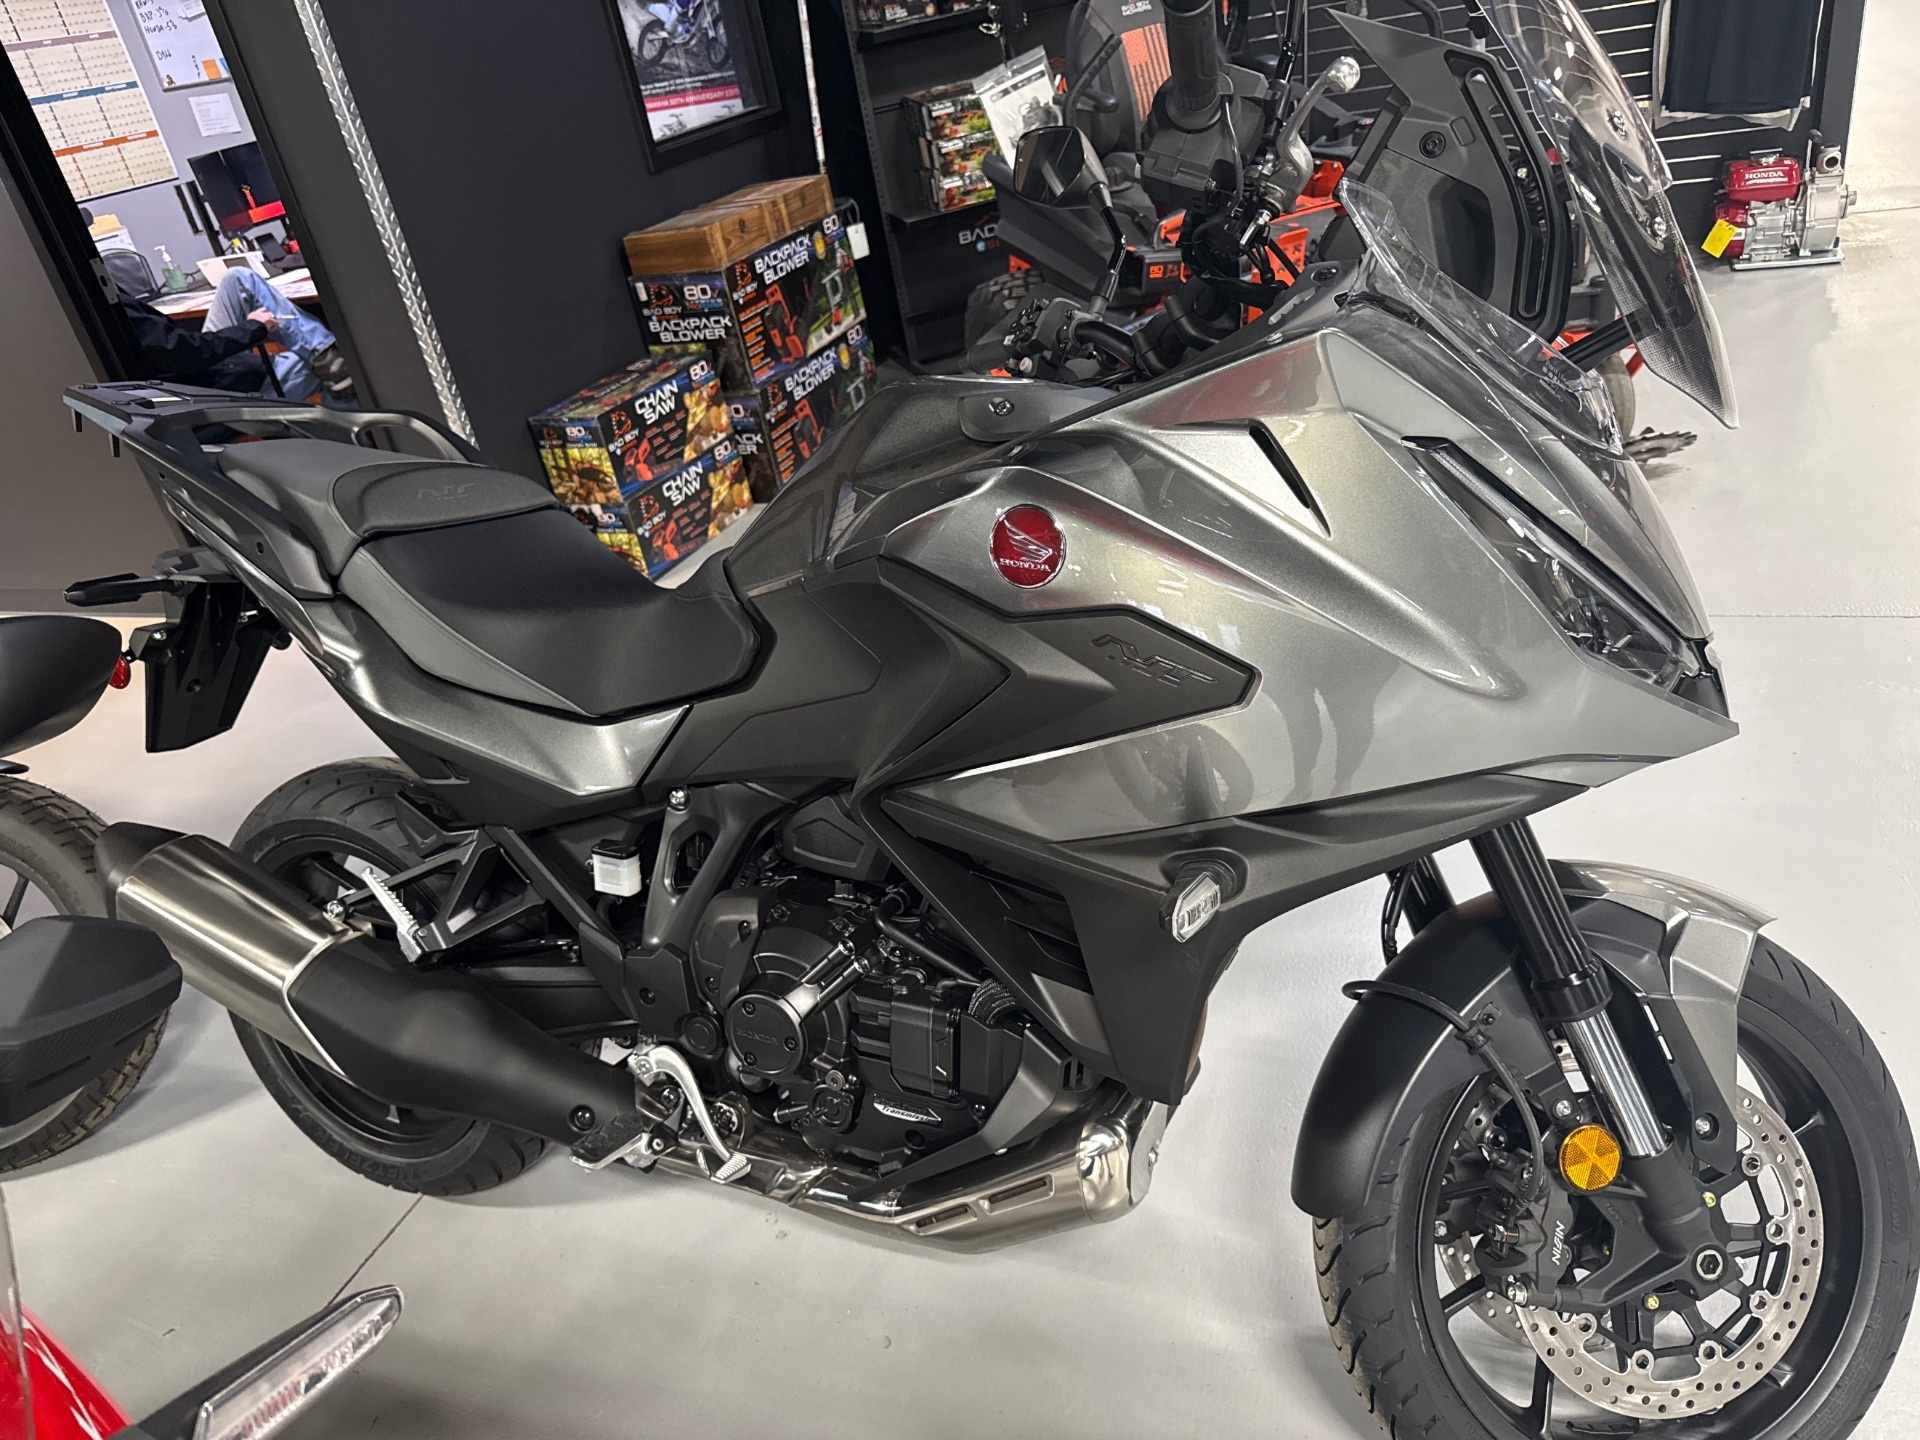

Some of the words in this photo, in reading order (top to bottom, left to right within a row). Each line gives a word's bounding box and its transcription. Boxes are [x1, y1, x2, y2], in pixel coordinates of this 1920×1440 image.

[1744, 171, 1785, 180] HONDA
[754, 233, 812, 275] BACKPACK
[763, 250, 810, 285] BLOWER
[648, 315, 733, 333] BACKPACK
[660, 328, 727, 343] BLOWER
[784, 346, 838, 393] BACKPACK
[792, 362, 836, 401] BLOWER
[634, 379, 679, 415] CHAIN
[643, 395, 676, 425] SAW
[608, 437, 625, 452] BAD
[624, 428, 640, 442] BOY
[662, 461, 703, 498] CHAIN
[671, 476, 700, 507] SAW
[637, 518, 653, 536] BAD
[652, 510, 667, 525] BOY
[999, 557, 1051, 572] HONDA
[736, 1029, 781, 1046] HONDA
[881, 1105, 940, 1125] Transmission
[1551, 1220, 1566, 1266] NISSIN
